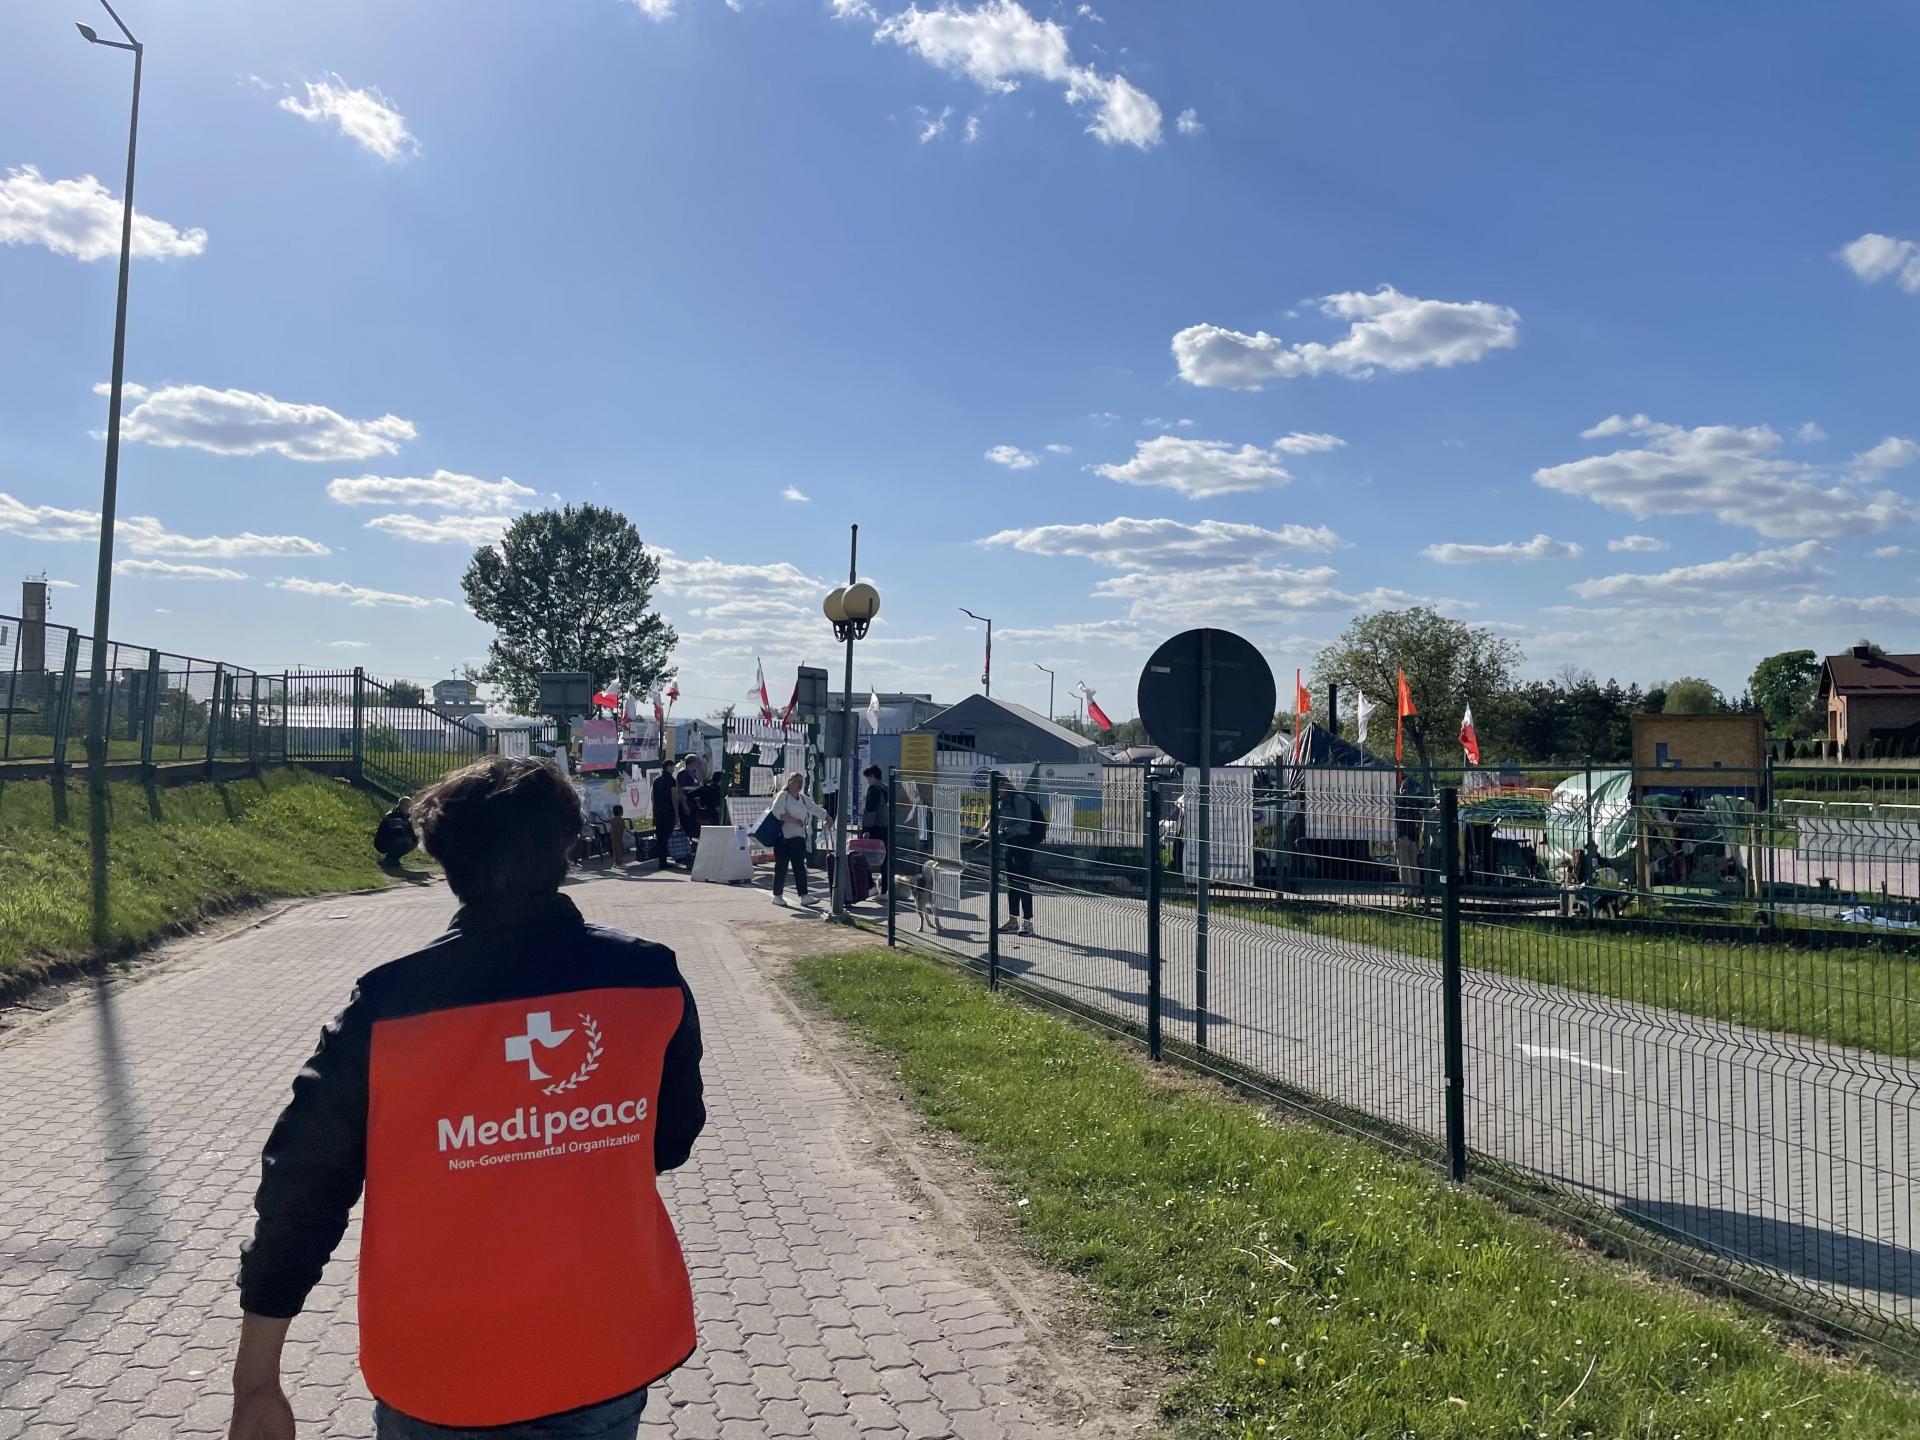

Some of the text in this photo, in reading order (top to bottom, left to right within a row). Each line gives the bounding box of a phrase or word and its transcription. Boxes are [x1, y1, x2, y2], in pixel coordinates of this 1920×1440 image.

[438, 1097, 648, 1152] Medipeace
[448, 1133, 641, 1171] Non-Governmental Organization
